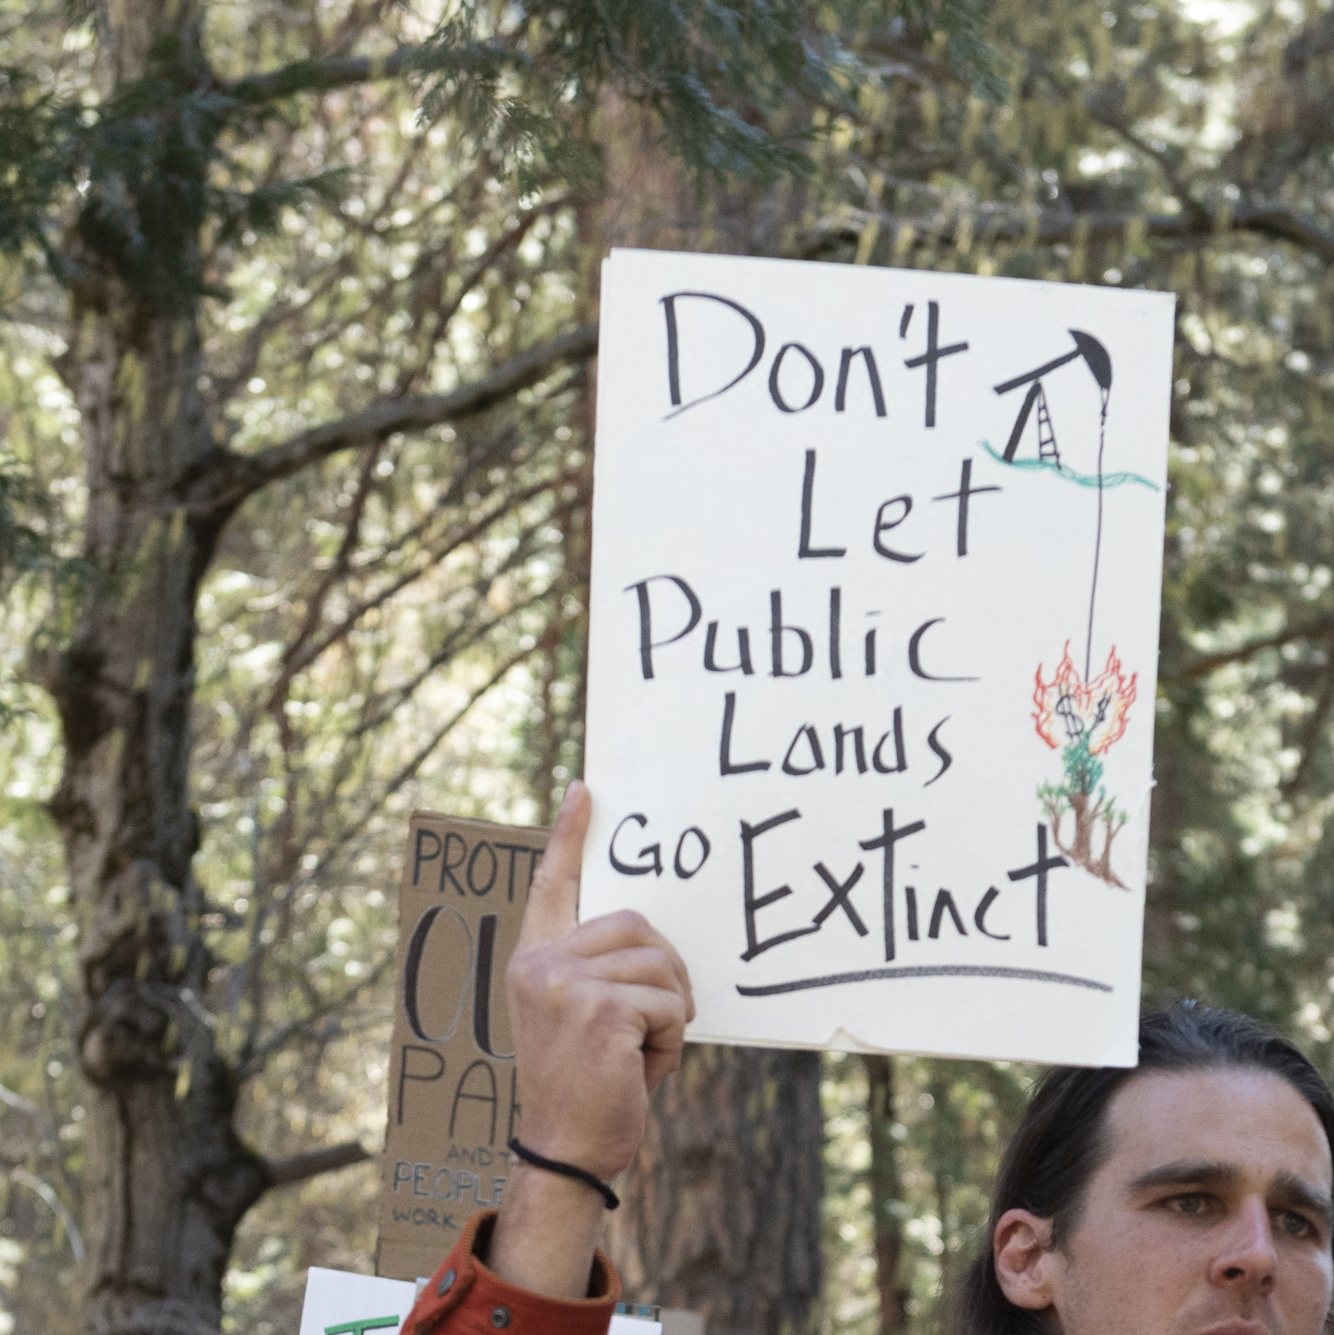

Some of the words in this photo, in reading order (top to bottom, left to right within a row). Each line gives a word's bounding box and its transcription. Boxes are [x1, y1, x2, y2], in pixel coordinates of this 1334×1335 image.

[660, 292, 969, 428] Don't
[798, 449, 1003, 563] Let
[623, 574, 980, 682] Public
[720, 691, 952, 786] Lands
[739, 808, 1072, 962] Extinct
[398, 1045, 522, 1146] PA
[393, 1161, 507, 1206] PEOPLE
[393, 1208, 456, 1229] WORK
